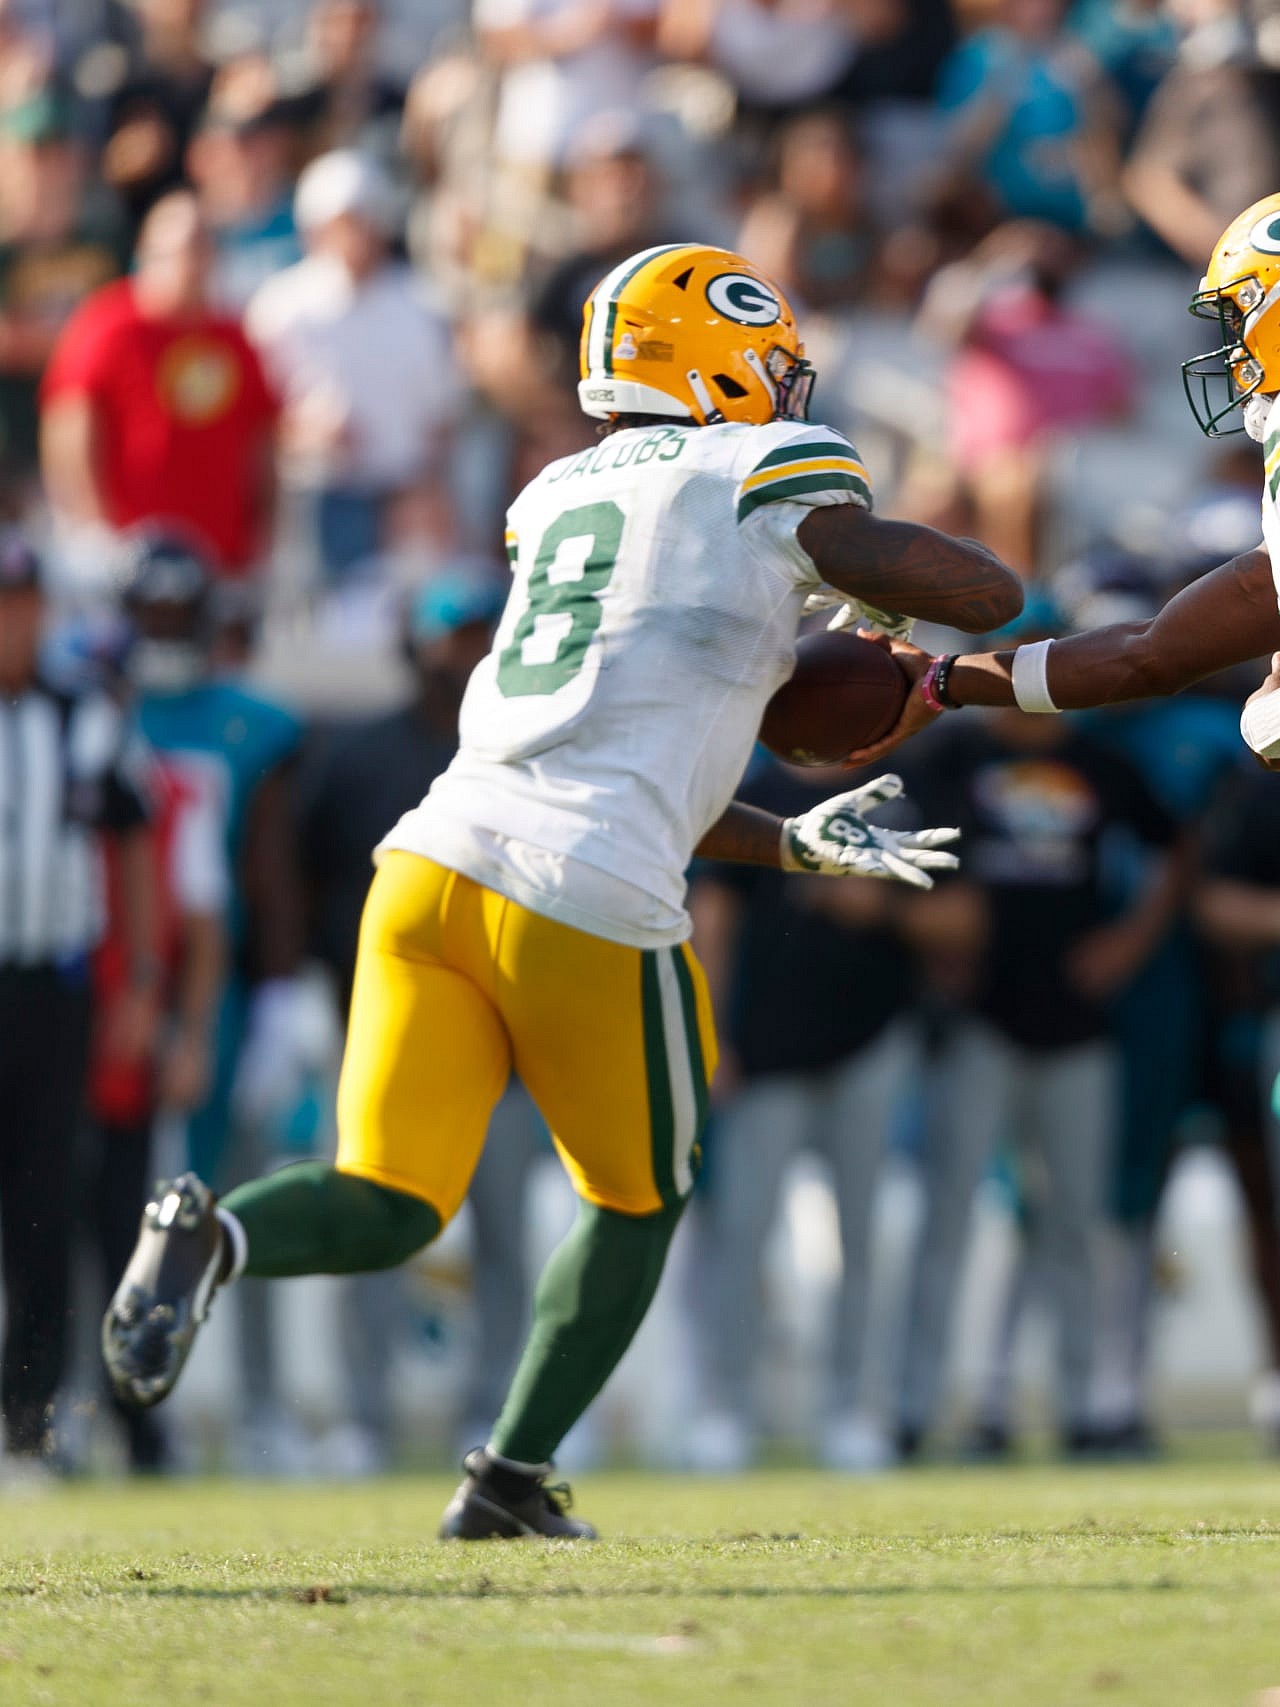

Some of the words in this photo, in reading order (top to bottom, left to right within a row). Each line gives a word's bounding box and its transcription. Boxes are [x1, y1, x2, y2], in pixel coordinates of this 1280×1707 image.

[705, 272, 781, 328] G
[547, 428, 689, 484] JACOBS
[496, 500, 626, 699] 8
[827, 818, 868, 843] 8
